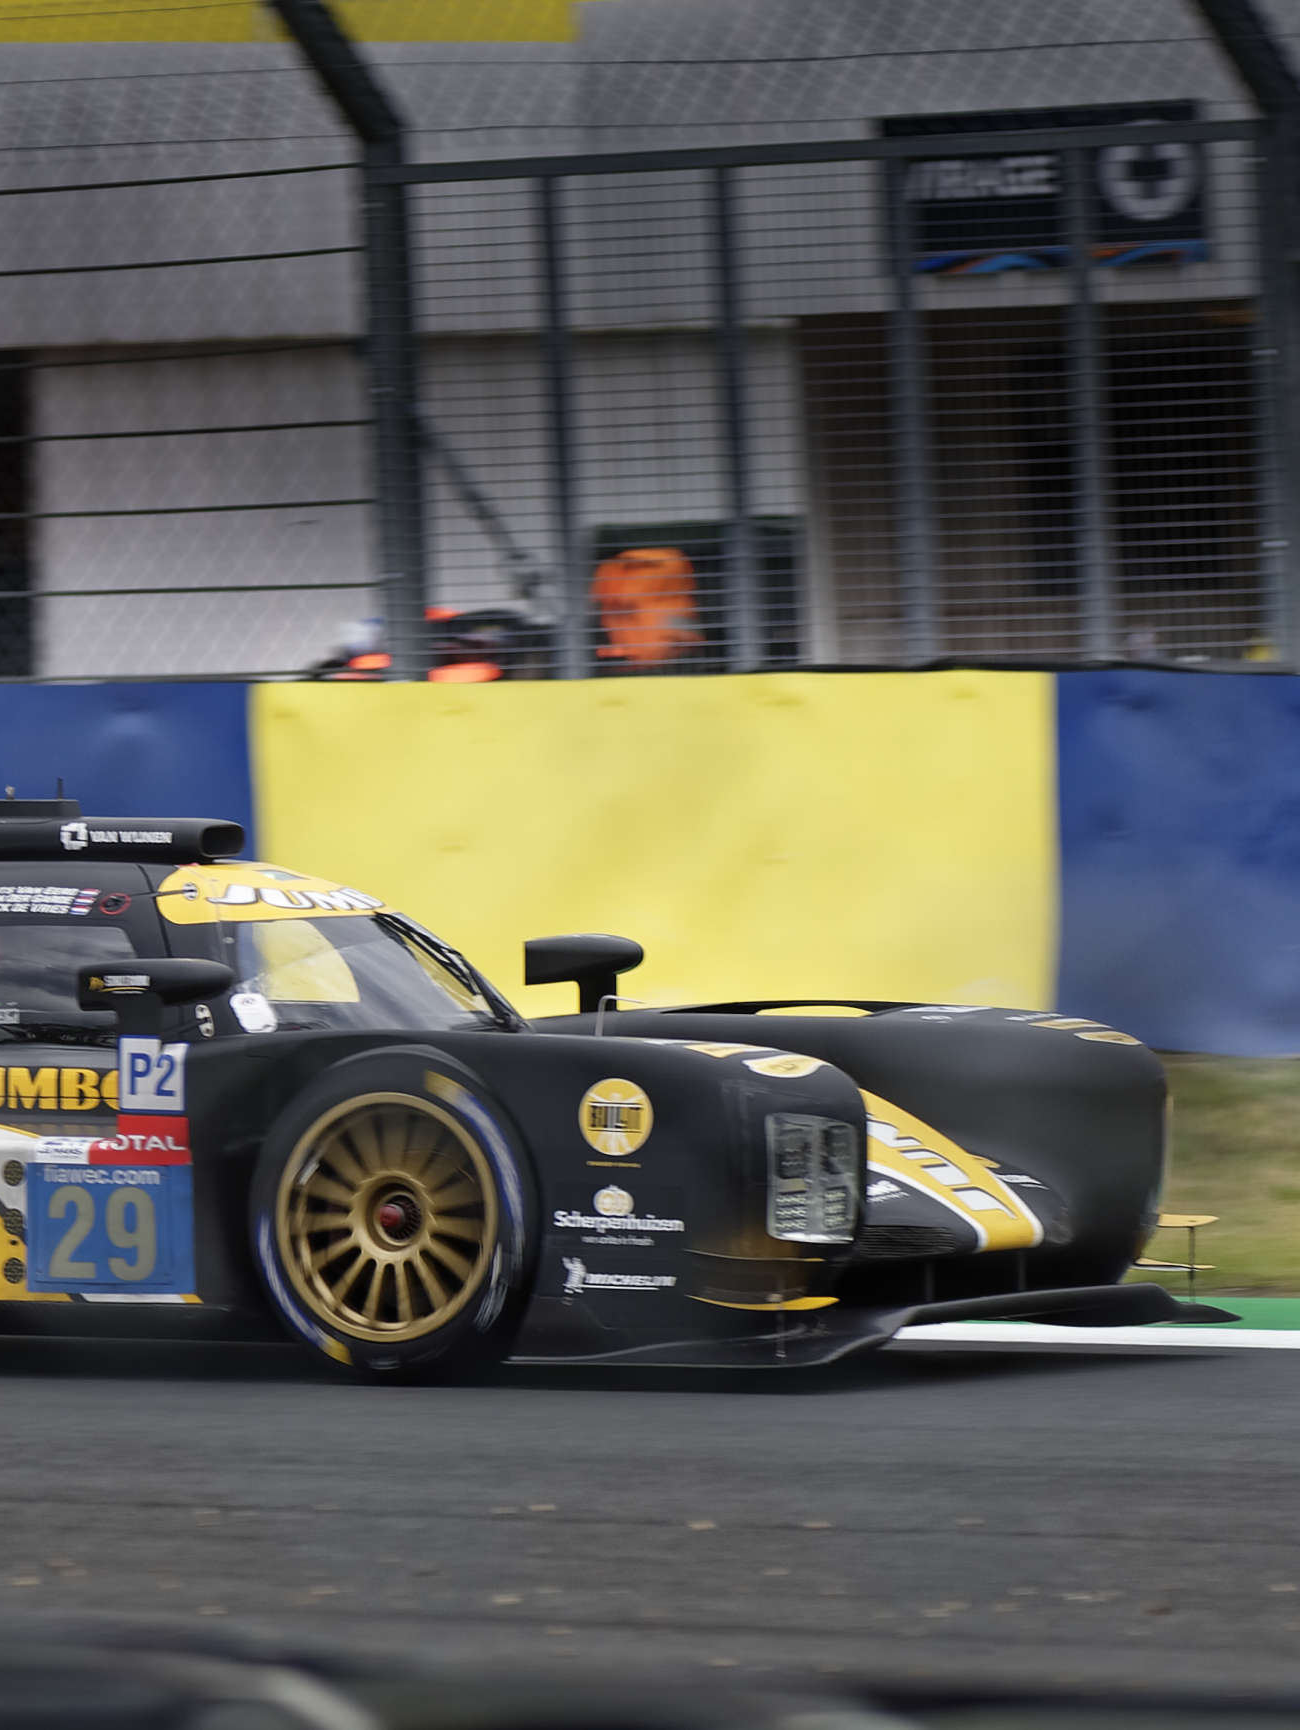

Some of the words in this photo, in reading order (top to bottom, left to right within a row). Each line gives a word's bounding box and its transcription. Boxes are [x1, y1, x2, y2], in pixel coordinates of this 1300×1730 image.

[127, 1053, 176, 1098] P2
[48, 1185, 158, 1282] 29
[553, 1210, 685, 1233] Scherpenhuizen
[585, 1273, 677, 1287] MICHELIN
